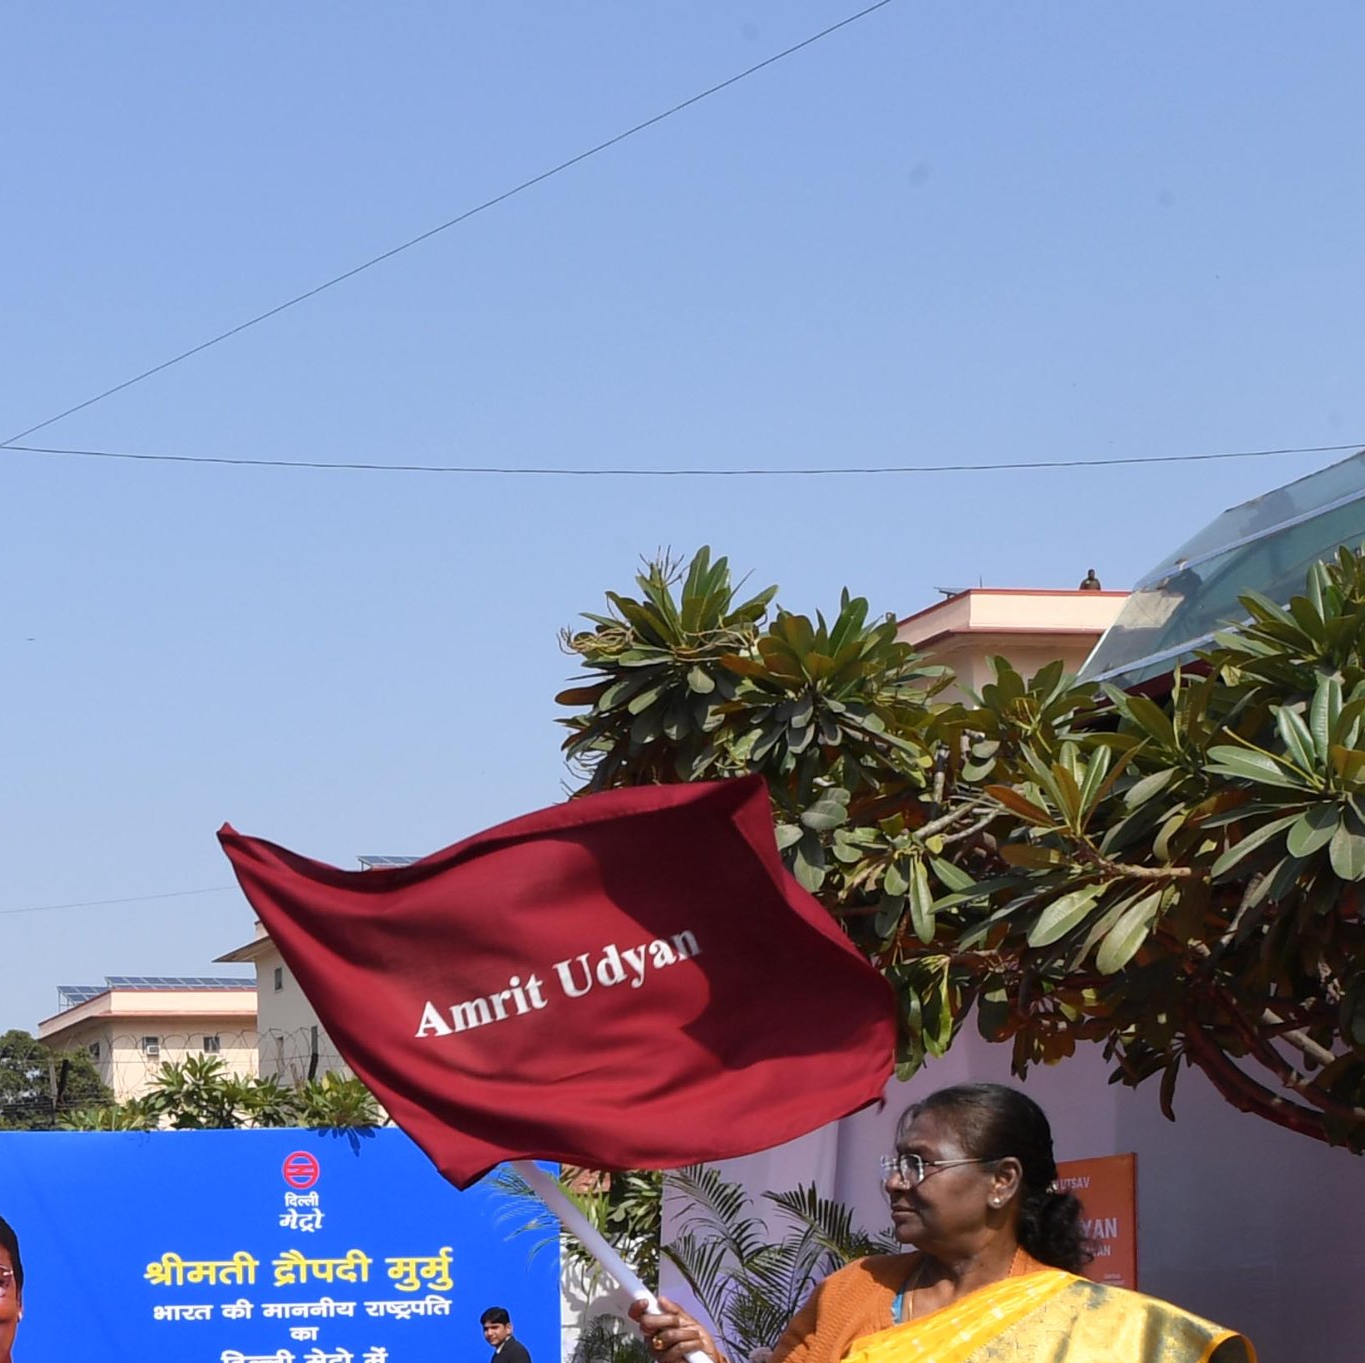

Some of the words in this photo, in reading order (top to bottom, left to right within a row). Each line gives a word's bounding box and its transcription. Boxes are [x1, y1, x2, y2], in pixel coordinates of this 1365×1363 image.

[415, 972, 548, 1038] Amrit
[552, 930, 702, 998] Udyan
[1060, 1176, 1091, 1190] UTSAV
[285, 1191, 319, 1208] दिल्ली
[279, 1208, 325, 1234] मेट्रो
[143, 1250, 259, 1288] श्रीमती
[273, 1247, 373, 1288] द्रौपदी
[385, 1246, 453, 1294] मुर्मु
[153, 1302, 211, 1322] भारत
[222, 1299, 254, 1321] की
[263, 1299, 355, 1320] माननीय
[365, 1295, 452, 1322] राष्ट्रपति
[290, 1326, 319, 1343] का
